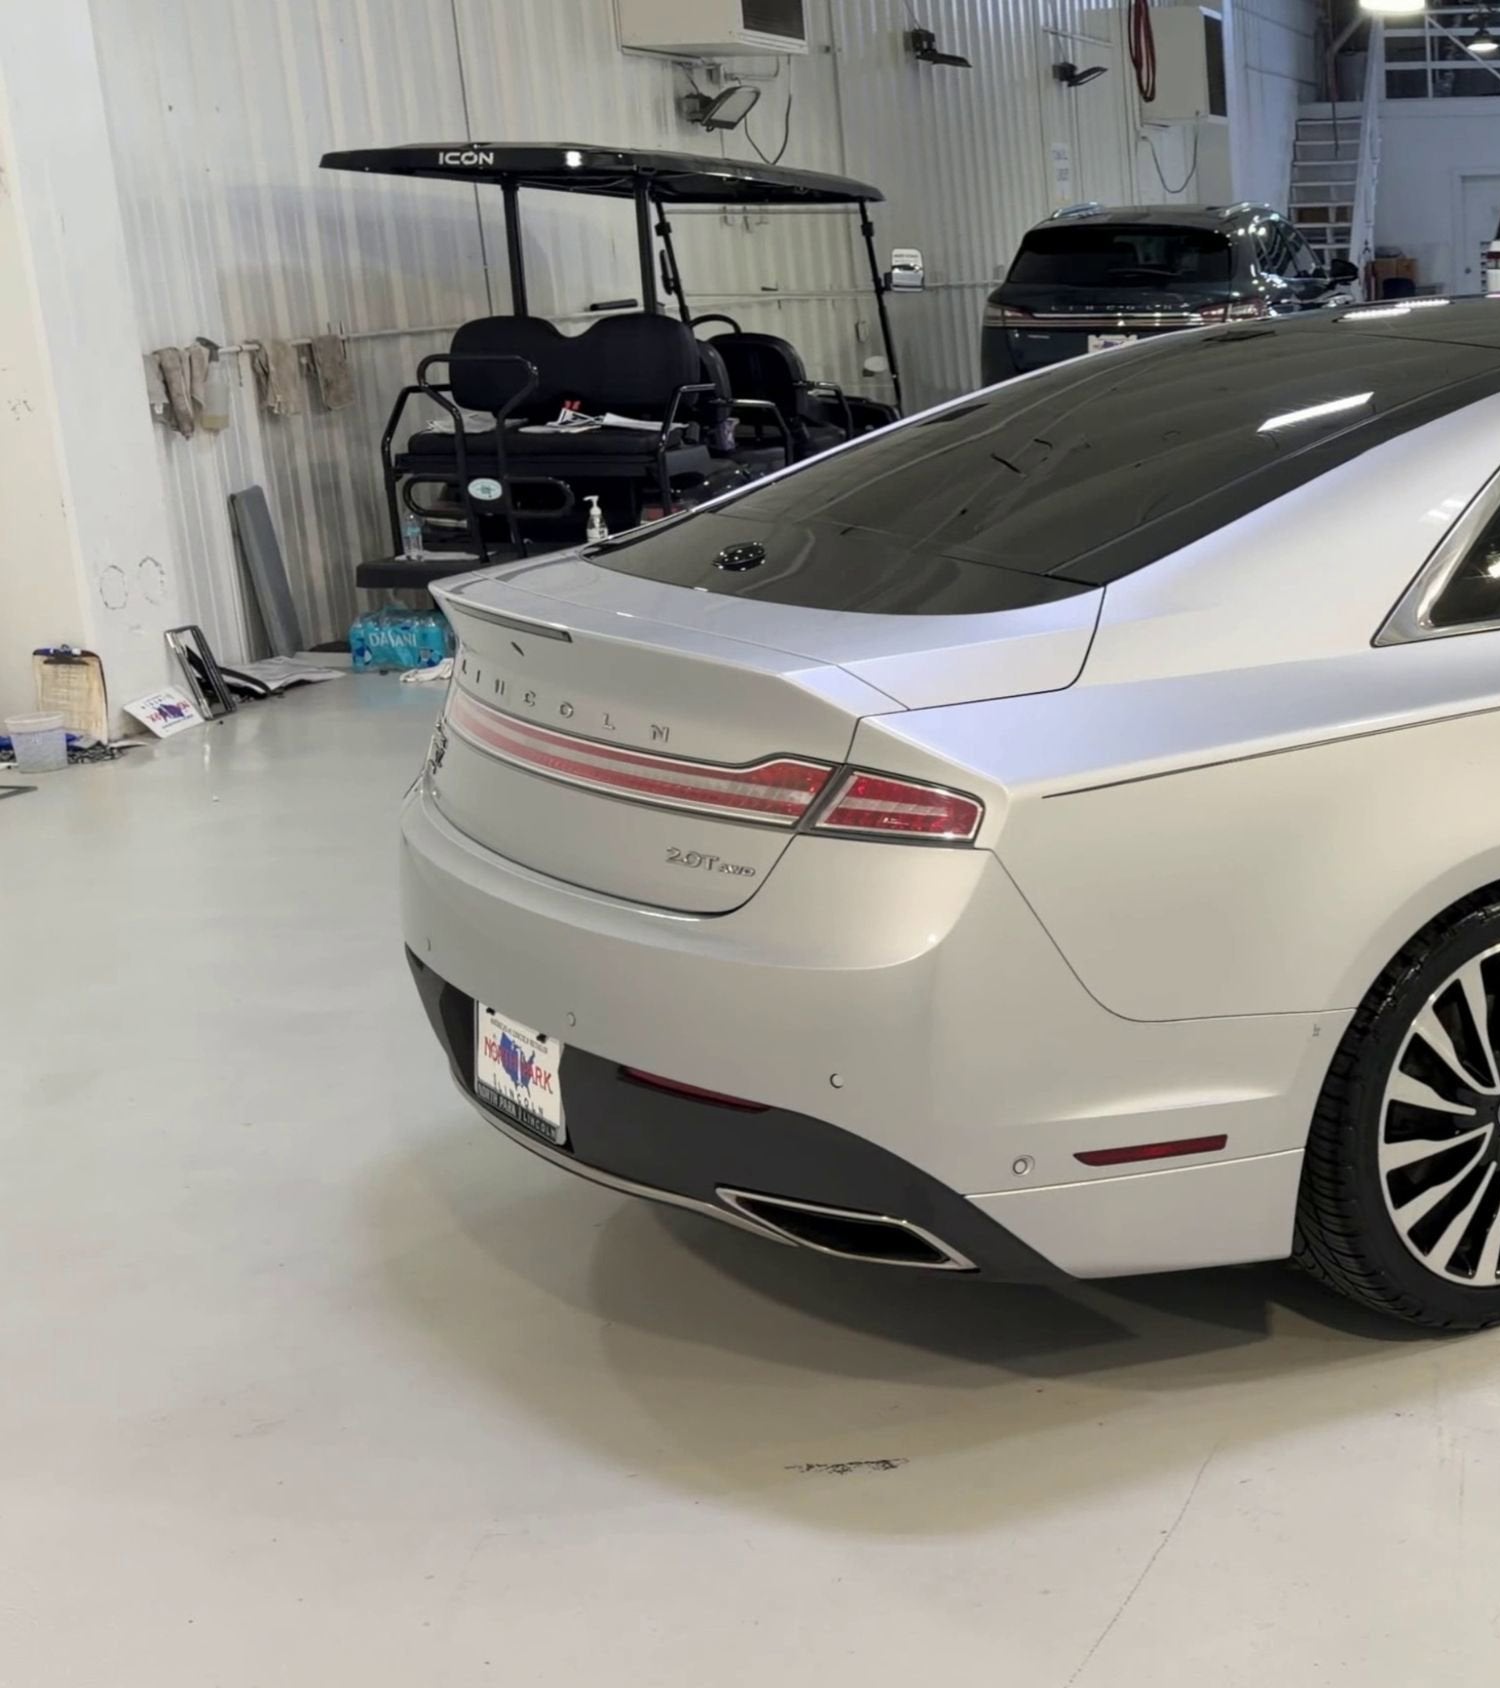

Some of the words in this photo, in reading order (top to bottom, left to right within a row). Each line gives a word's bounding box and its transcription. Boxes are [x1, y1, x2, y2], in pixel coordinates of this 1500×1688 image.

[438, 151, 495, 166] ICON
[368, 629, 417, 648] DASANI
[460, 658, 671, 744] LINCOLN
[519, 1057, 553, 1095] PARK
